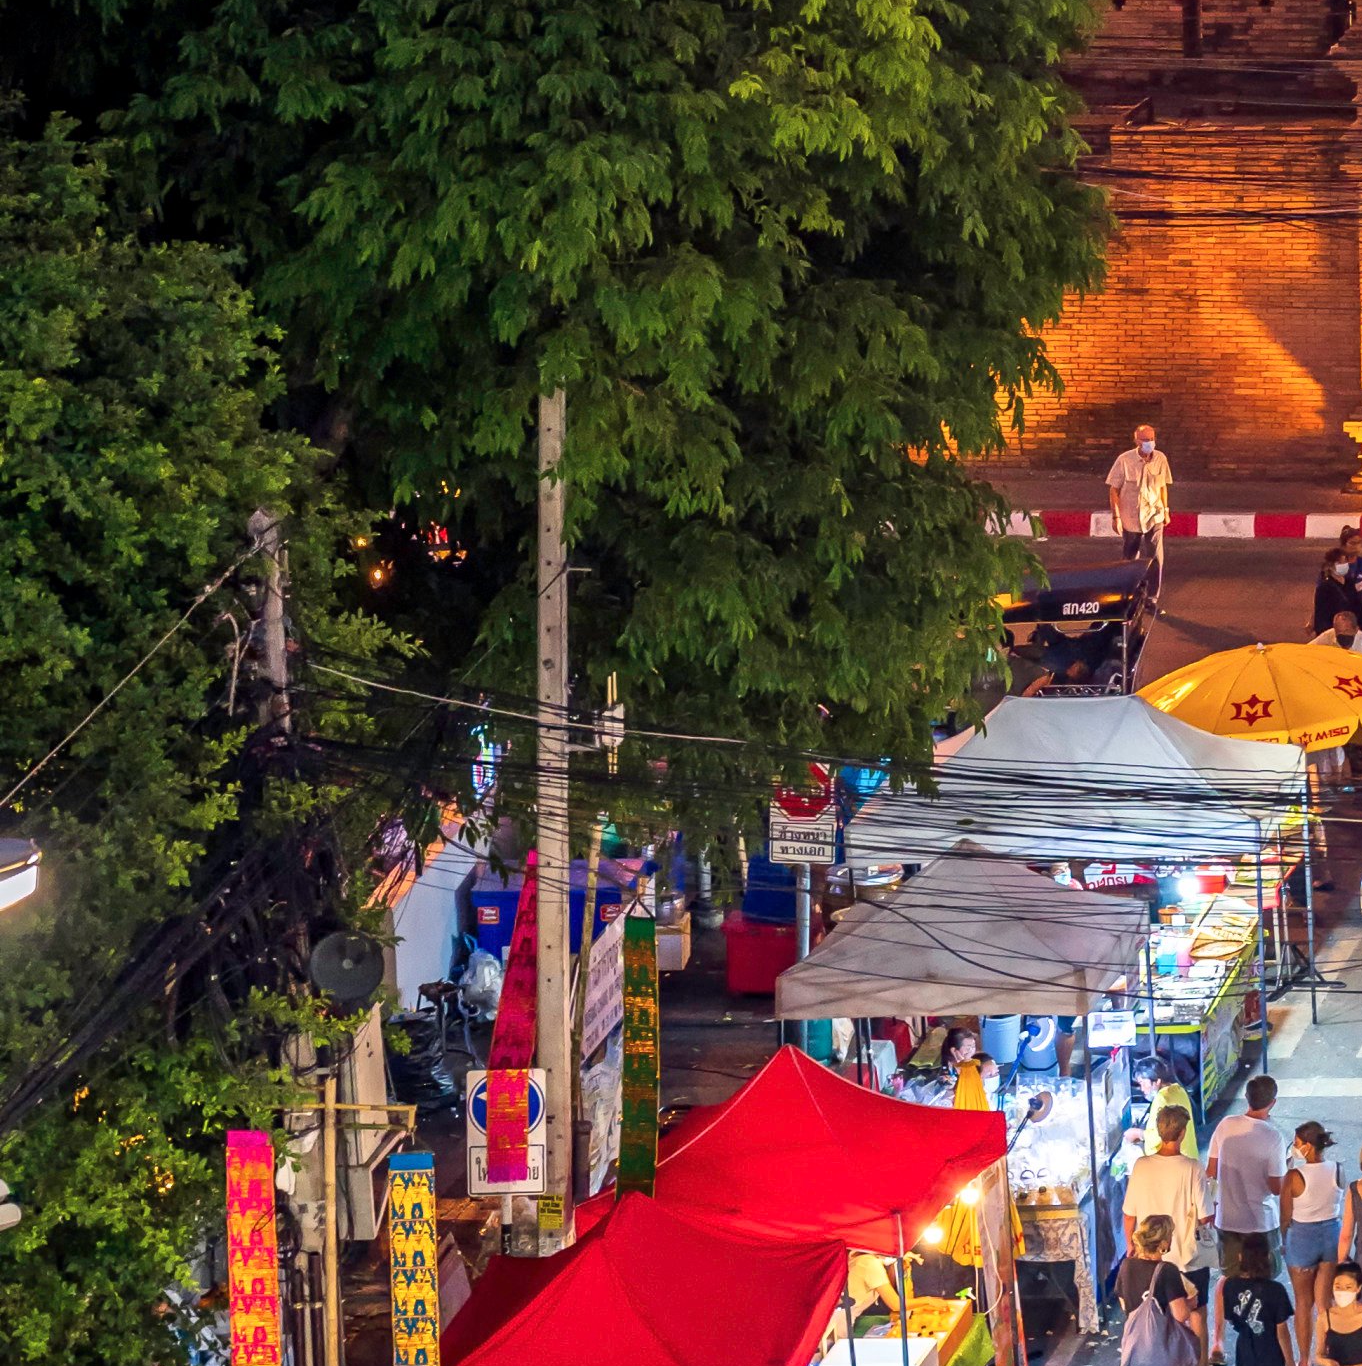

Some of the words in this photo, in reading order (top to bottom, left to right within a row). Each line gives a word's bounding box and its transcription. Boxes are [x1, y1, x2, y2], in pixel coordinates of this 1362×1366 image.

[1315, 725, 1350, 742] M-150
[779, 845, 825, 856] ทางเอก
